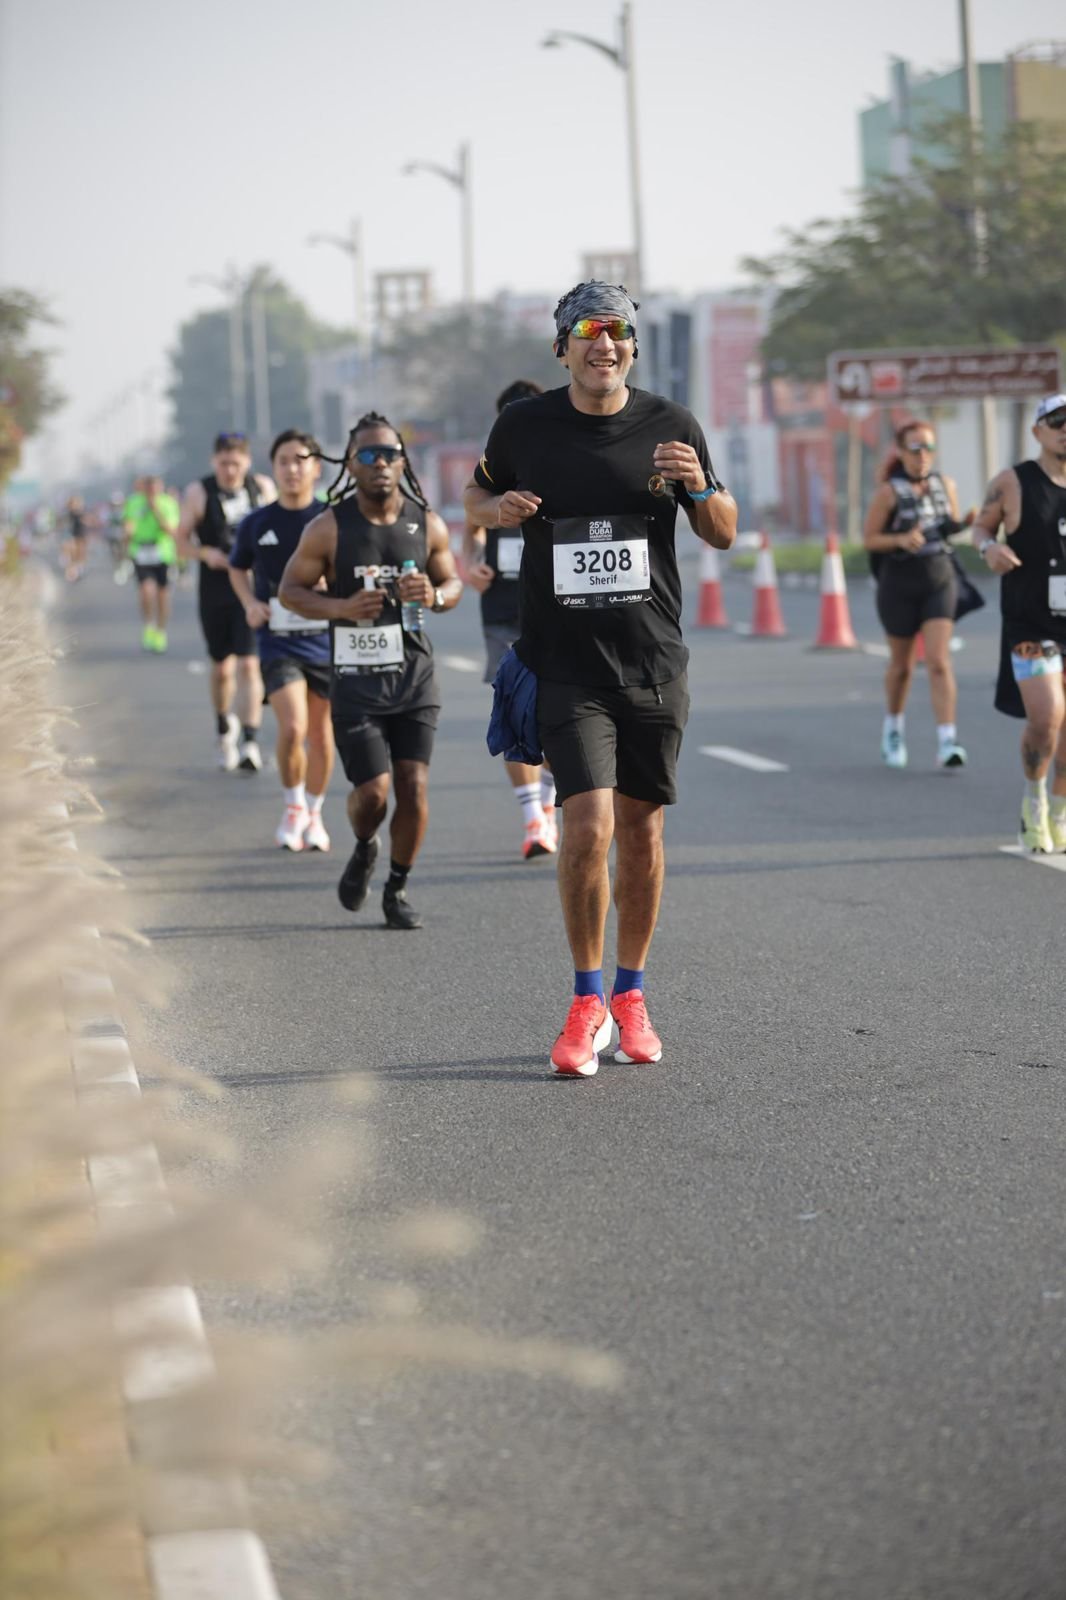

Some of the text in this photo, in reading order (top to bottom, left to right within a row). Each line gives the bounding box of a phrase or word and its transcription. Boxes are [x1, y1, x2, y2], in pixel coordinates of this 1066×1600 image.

[573, 548, 632, 574] 3208
[590, 575, 618, 586] Sherif
[349, 633, 388, 649] 3656
